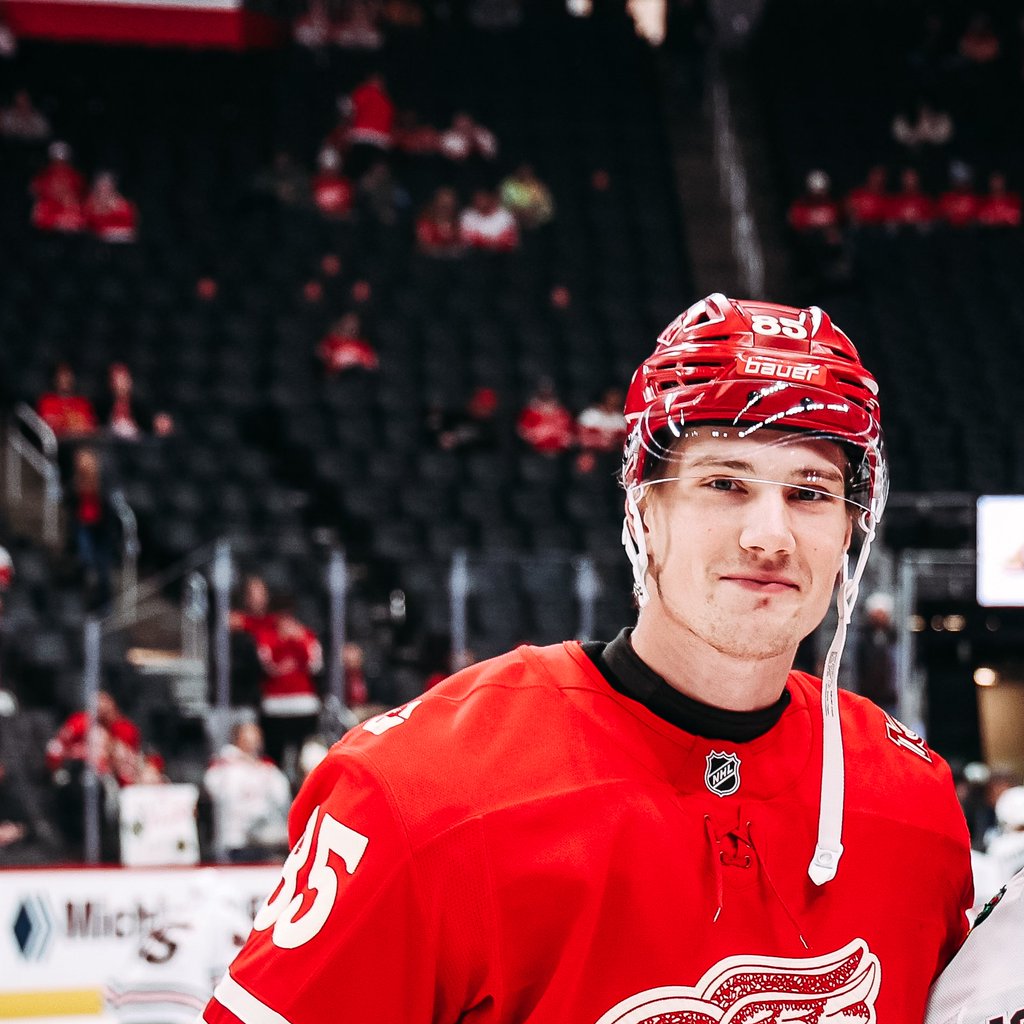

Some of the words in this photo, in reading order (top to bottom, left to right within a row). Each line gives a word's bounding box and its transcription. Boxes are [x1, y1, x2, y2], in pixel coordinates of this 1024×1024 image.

[751, 311, 808, 340] 85
[744, 356, 820, 381] bauer
[712, 763, 734, 786] NHL
[253, 804, 370, 950] 85
